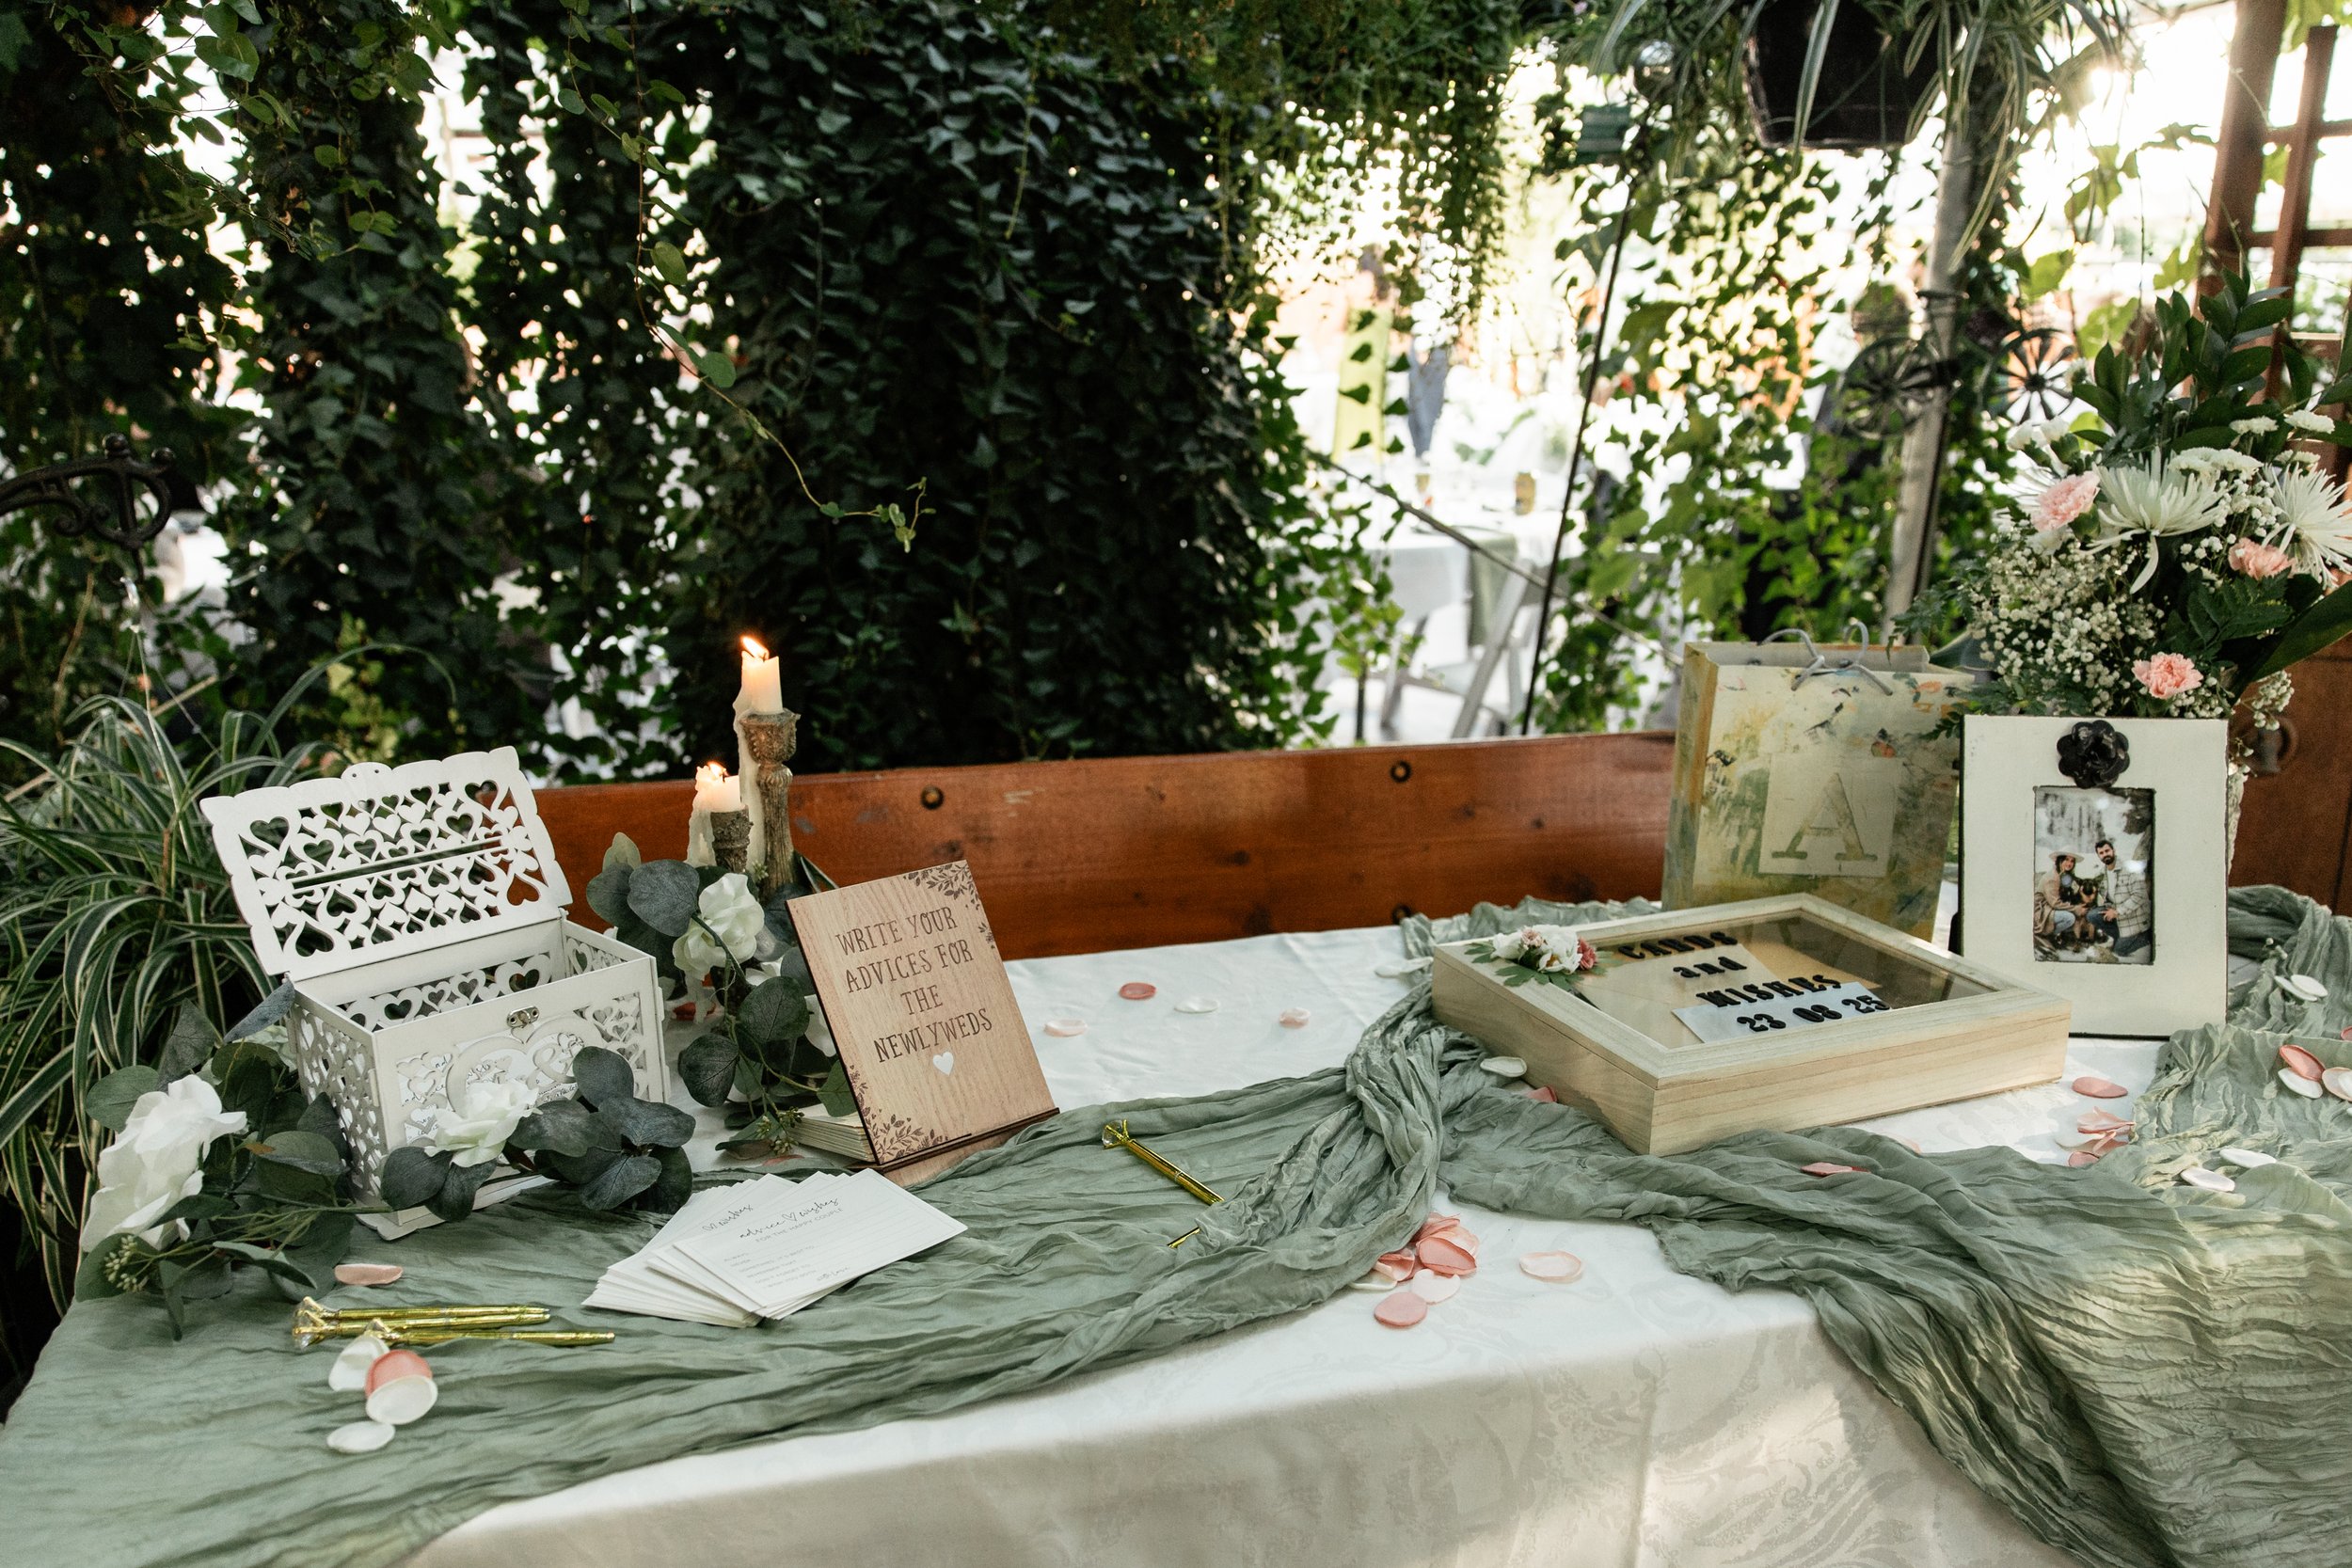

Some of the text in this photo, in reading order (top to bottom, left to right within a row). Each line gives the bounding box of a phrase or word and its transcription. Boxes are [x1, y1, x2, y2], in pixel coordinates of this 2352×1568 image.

[1771, 771, 1878, 861] A
[835, 906, 958, 956] WRITE YOUR
[1618, 931, 1738, 958] CARDS
[845, 939, 974, 993] ADVICES FOR
[1673, 956, 1747, 978] and
[900, 984, 944, 1016] THE
[1696, 974, 1841, 1007] WISHES
[1737, 995, 1890, 1032] 23 08 25
[873, 1007, 993, 1063] NEWLYWEDS
[739, 1197, 838, 1239] advice wishes
